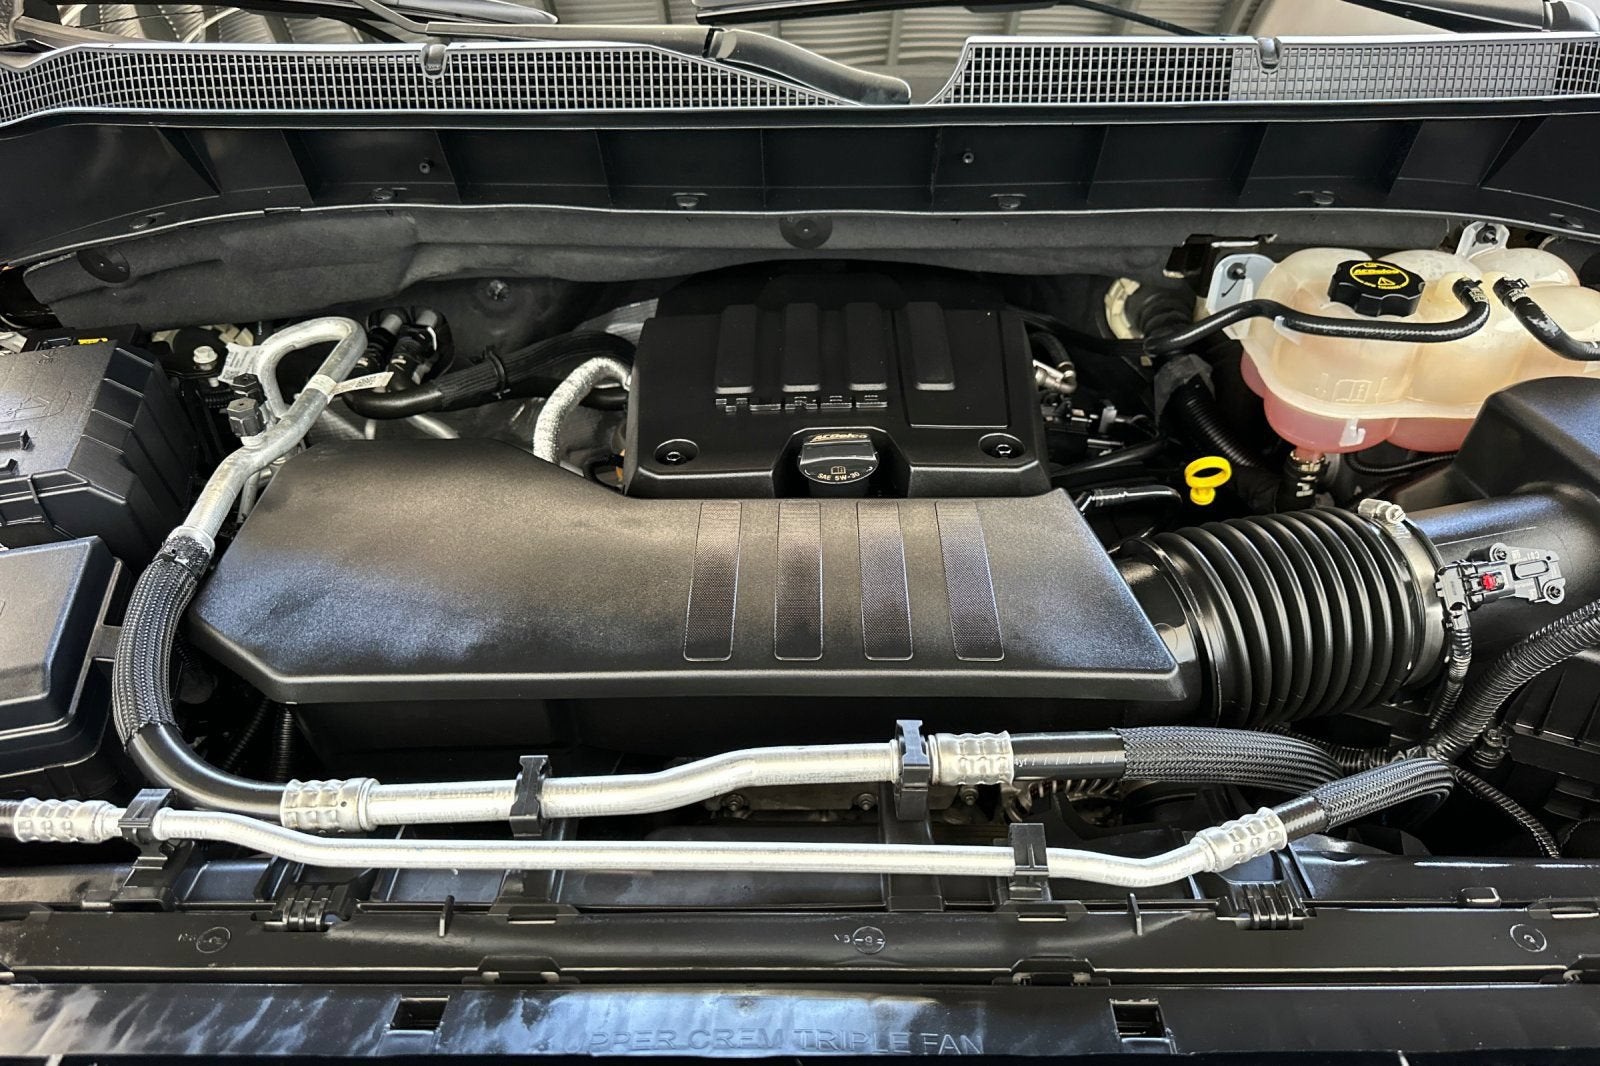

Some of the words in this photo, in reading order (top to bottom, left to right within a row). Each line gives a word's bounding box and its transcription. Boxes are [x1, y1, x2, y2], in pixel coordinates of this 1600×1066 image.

[817, 472, 832, 481] SAE
[834, 471, 861, 481] 5W-30
[794, 1029, 912, 1054] TRIPLE
[920, 1033, 985, 1055] FAN
